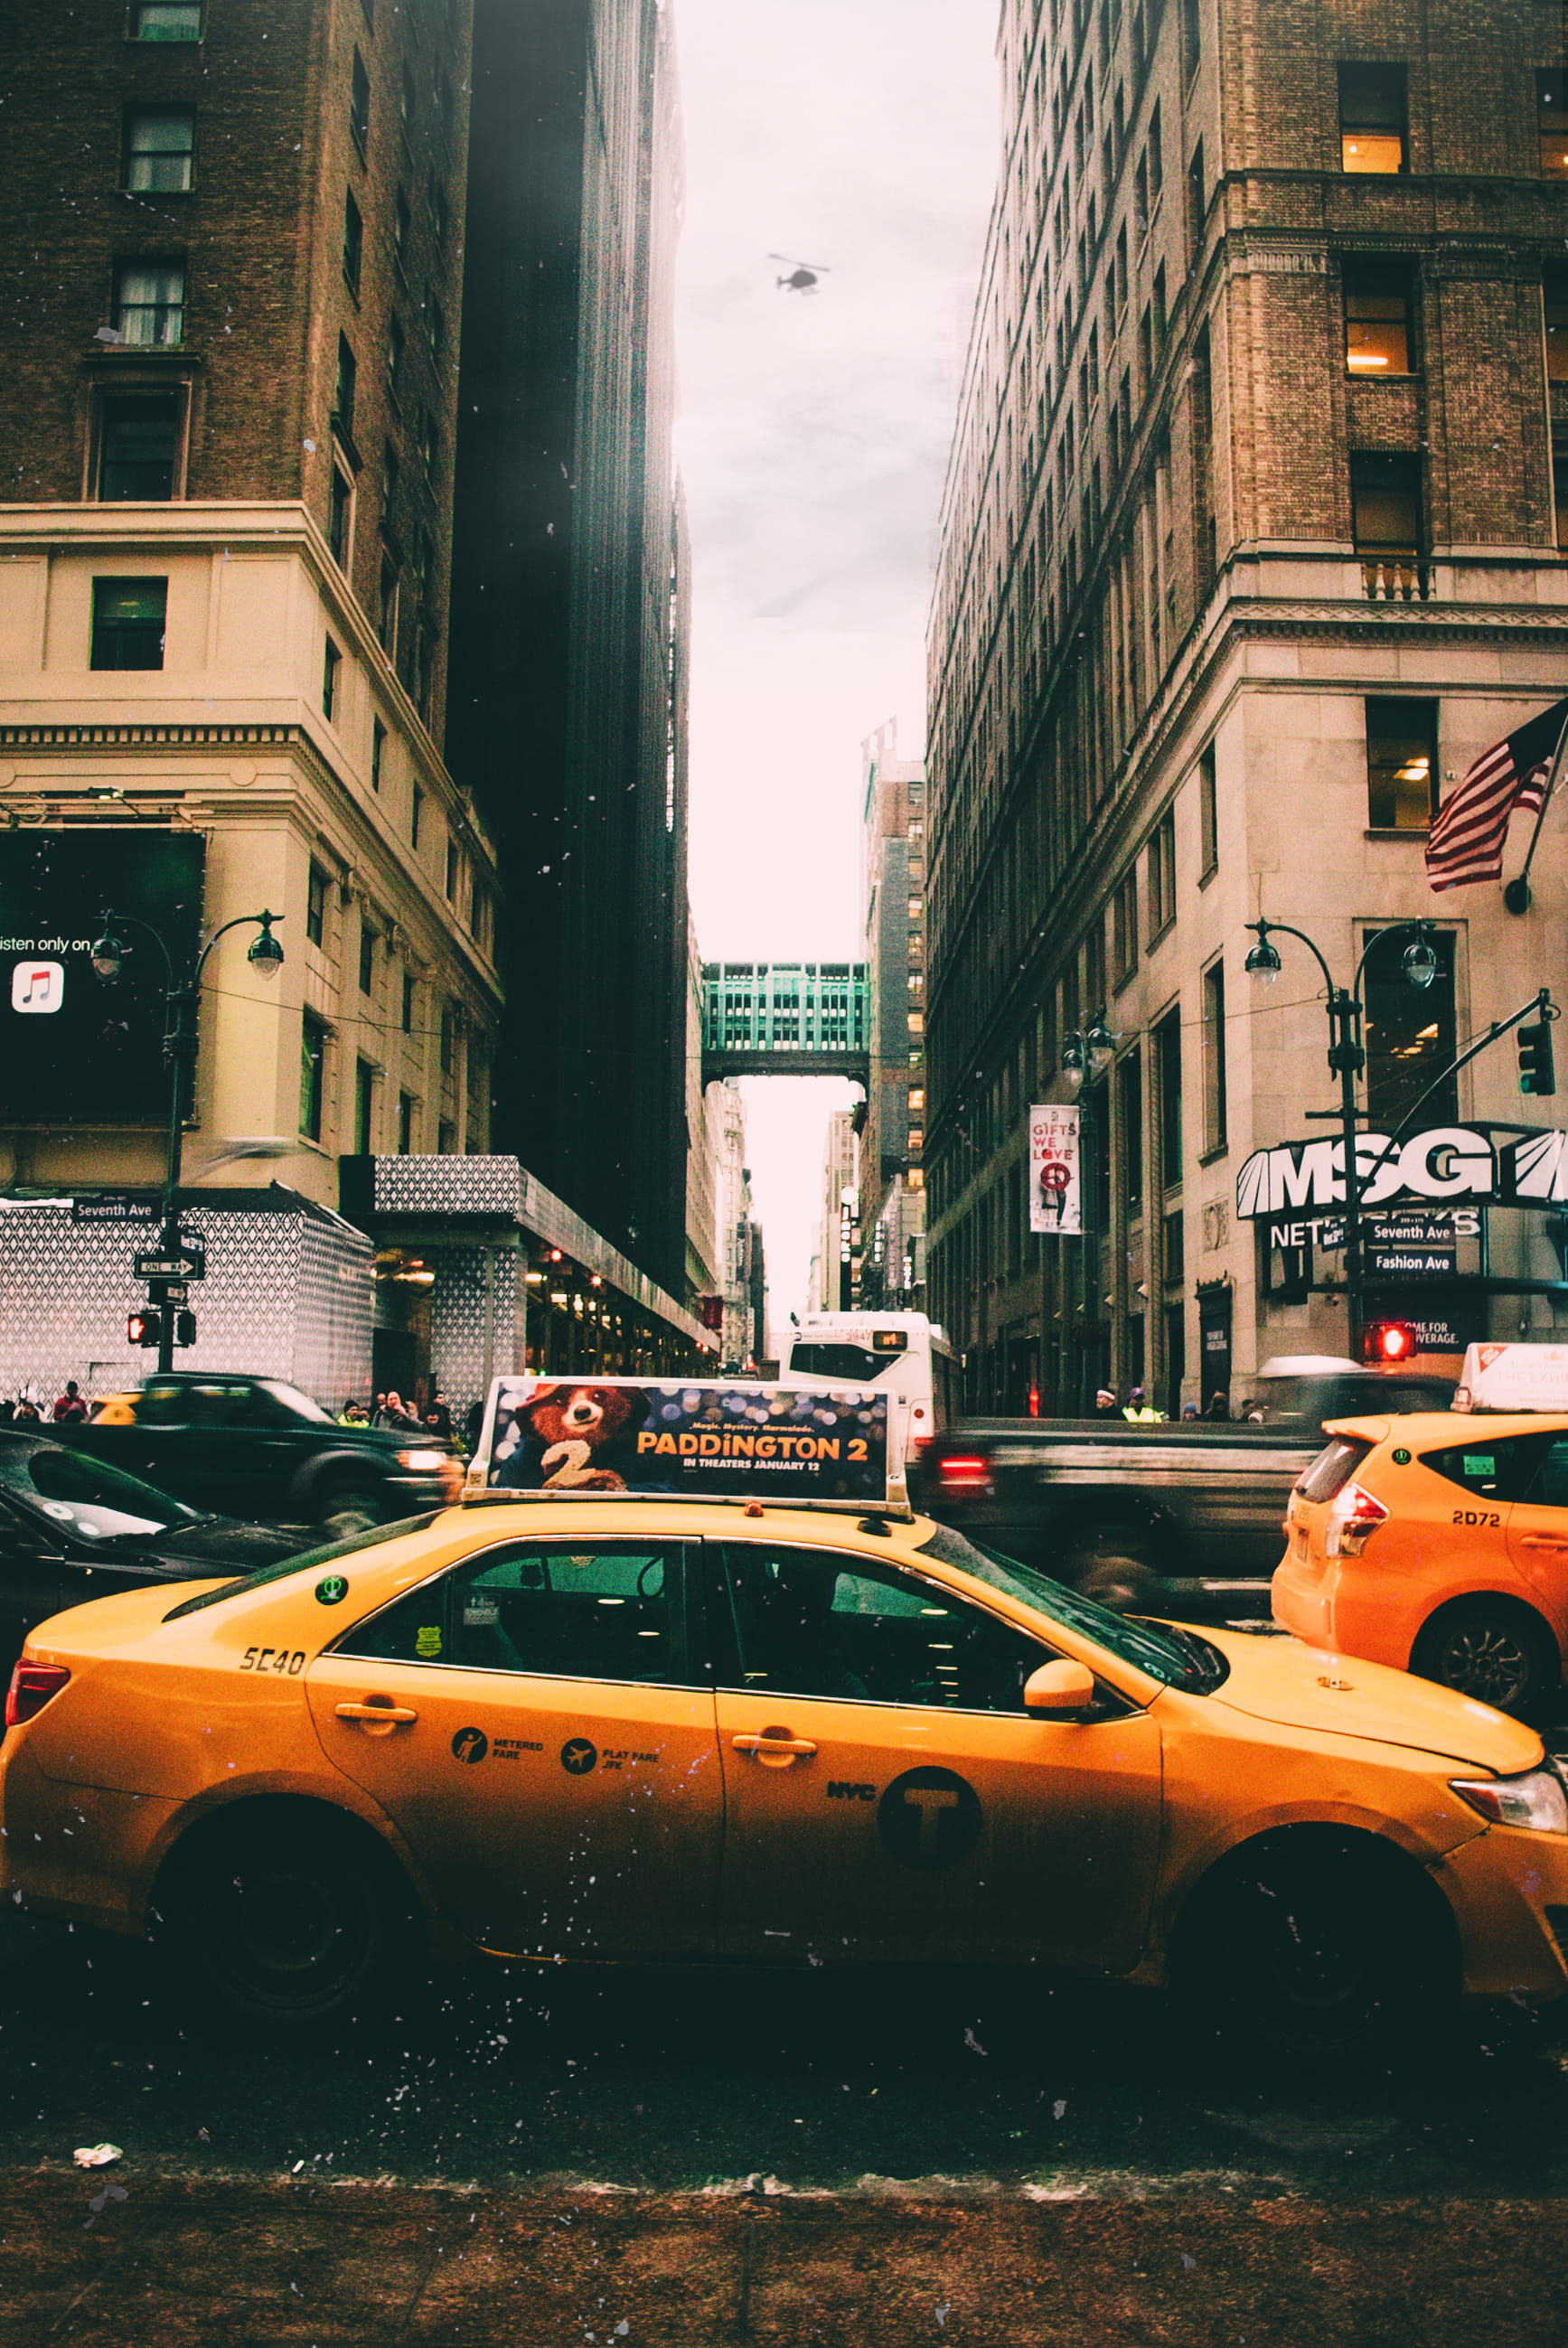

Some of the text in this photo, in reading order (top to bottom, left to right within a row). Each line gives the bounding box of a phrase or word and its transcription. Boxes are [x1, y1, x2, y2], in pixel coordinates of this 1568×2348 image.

[0, 936, 90, 954] isten only on
[1033, 1123, 1076, 1136] GIFTS
[1034, 1137, 1056, 1148] WE
[1269, 1127, 1493, 1208] MSG
[78, 1203, 152, 1216] Seventh Ave
[1374, 1225, 1450, 1239] Seventh Ave
[146, 1263, 188, 1272] ONE WAY
[1376, 1255, 1450, 1270] Fashion Ave
[1429, 1322, 1448, 1333] FOR
[636, 1431, 869, 1461] PADDINGTON 2
[683, 1458, 821, 1471] IN THEATERS JANUARY 12
[1452, 1510, 1500, 1527] 2D72
[493, 1739, 543, 1752] METERED
[493, 1750, 521, 1761] FARE
[602, 1749, 659, 1763] FLAT FARE
[827, 1780, 876, 1802] NYC
